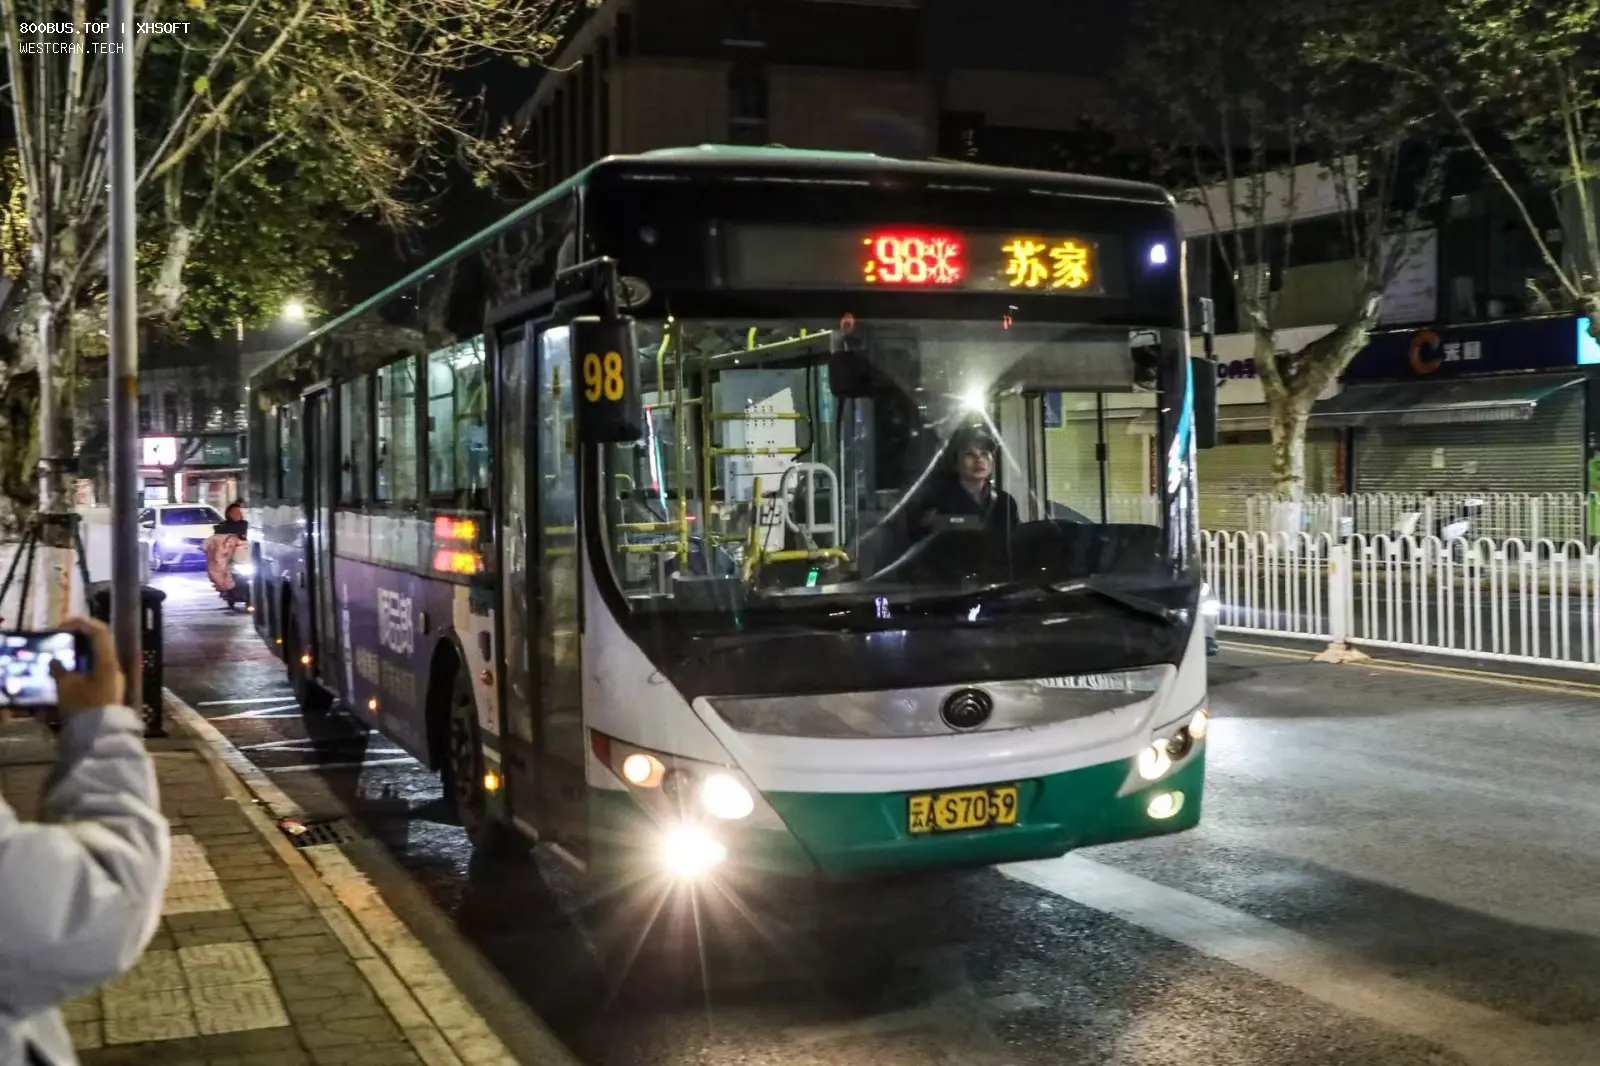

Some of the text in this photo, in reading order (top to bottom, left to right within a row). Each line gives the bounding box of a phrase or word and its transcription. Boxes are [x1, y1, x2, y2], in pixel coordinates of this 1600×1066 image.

[876, 236, 928, 283] 98
[1002, 240, 1089, 288] 苏家
[583, 351, 624, 402] 98
